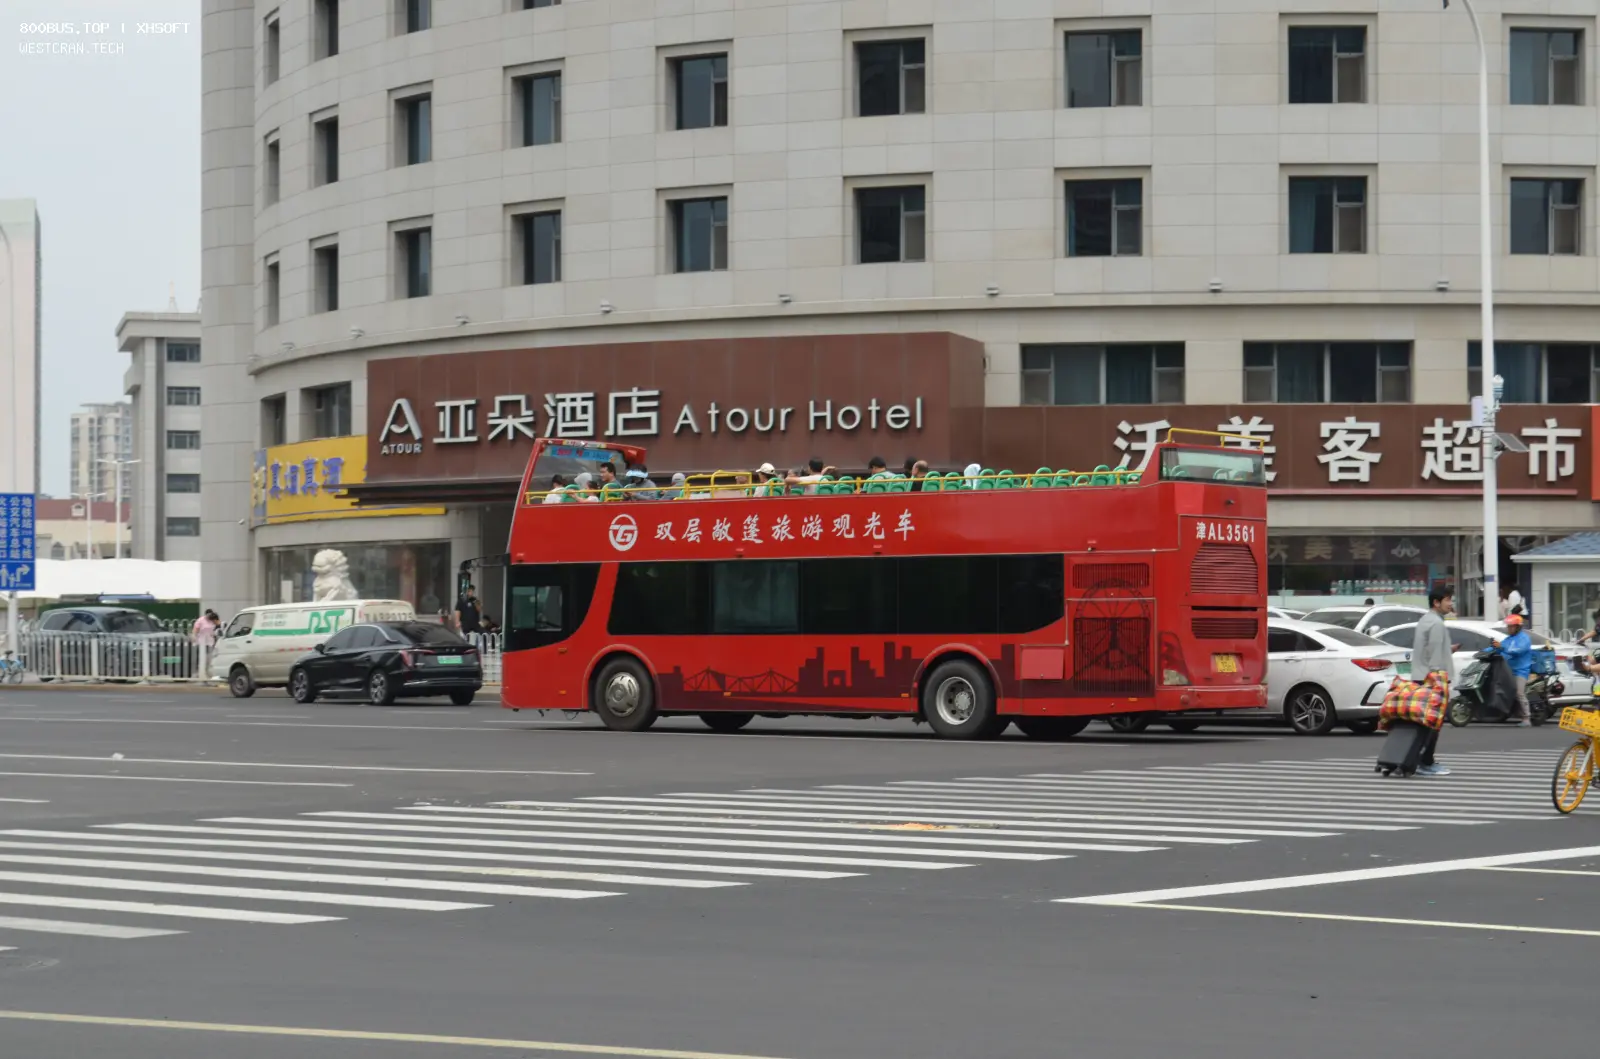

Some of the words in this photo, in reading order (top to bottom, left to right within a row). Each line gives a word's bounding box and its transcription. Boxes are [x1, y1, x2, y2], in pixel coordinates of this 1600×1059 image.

[432, 387, 661, 444] 亚朵酒店
[673, 402, 794, 434] Atour
[808, 396, 922, 431] Hotel
[381, 443, 422, 456] ATOUR
[653, 507, 916, 544] 双层敞篷旅游观光车
[1196, 521, 1256, 543] 津AL3561
